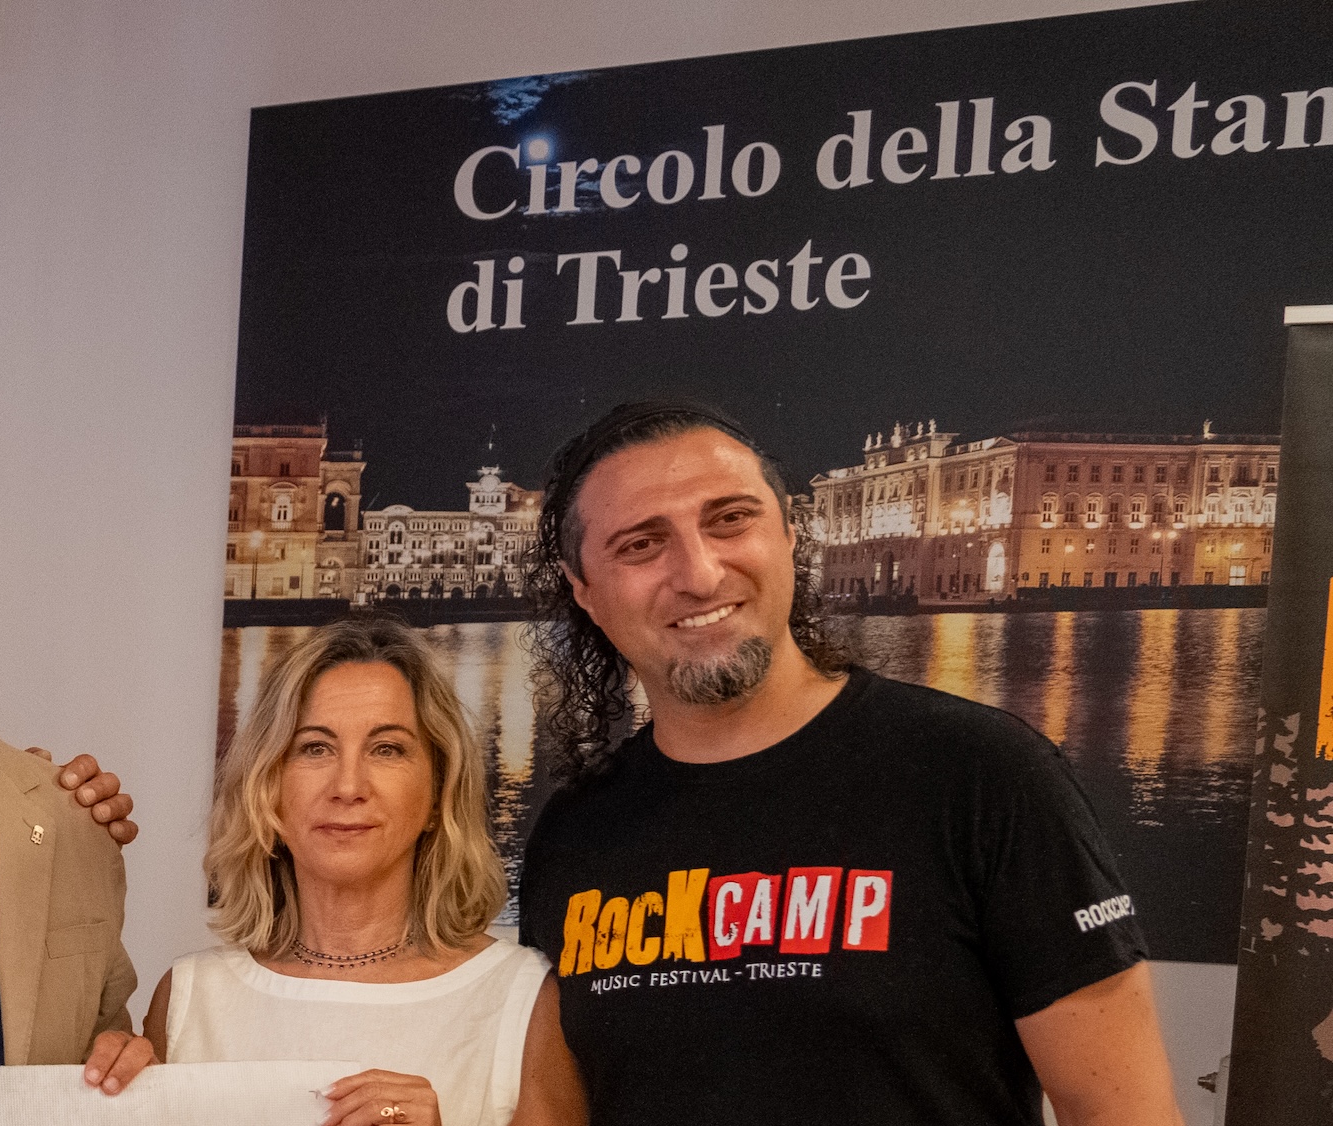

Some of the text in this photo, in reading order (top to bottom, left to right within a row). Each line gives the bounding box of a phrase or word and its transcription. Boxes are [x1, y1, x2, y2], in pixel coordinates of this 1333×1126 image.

[453, 124, 781, 221] Circolo
[816, 97, 1056, 190] della
[446, 239, 871, 333] di Trieste
[591, 974, 641, 994] MUSIC
[649, 968, 730, 987] FESTIVAL
[746, 962, 822, 980] TRIESTE
